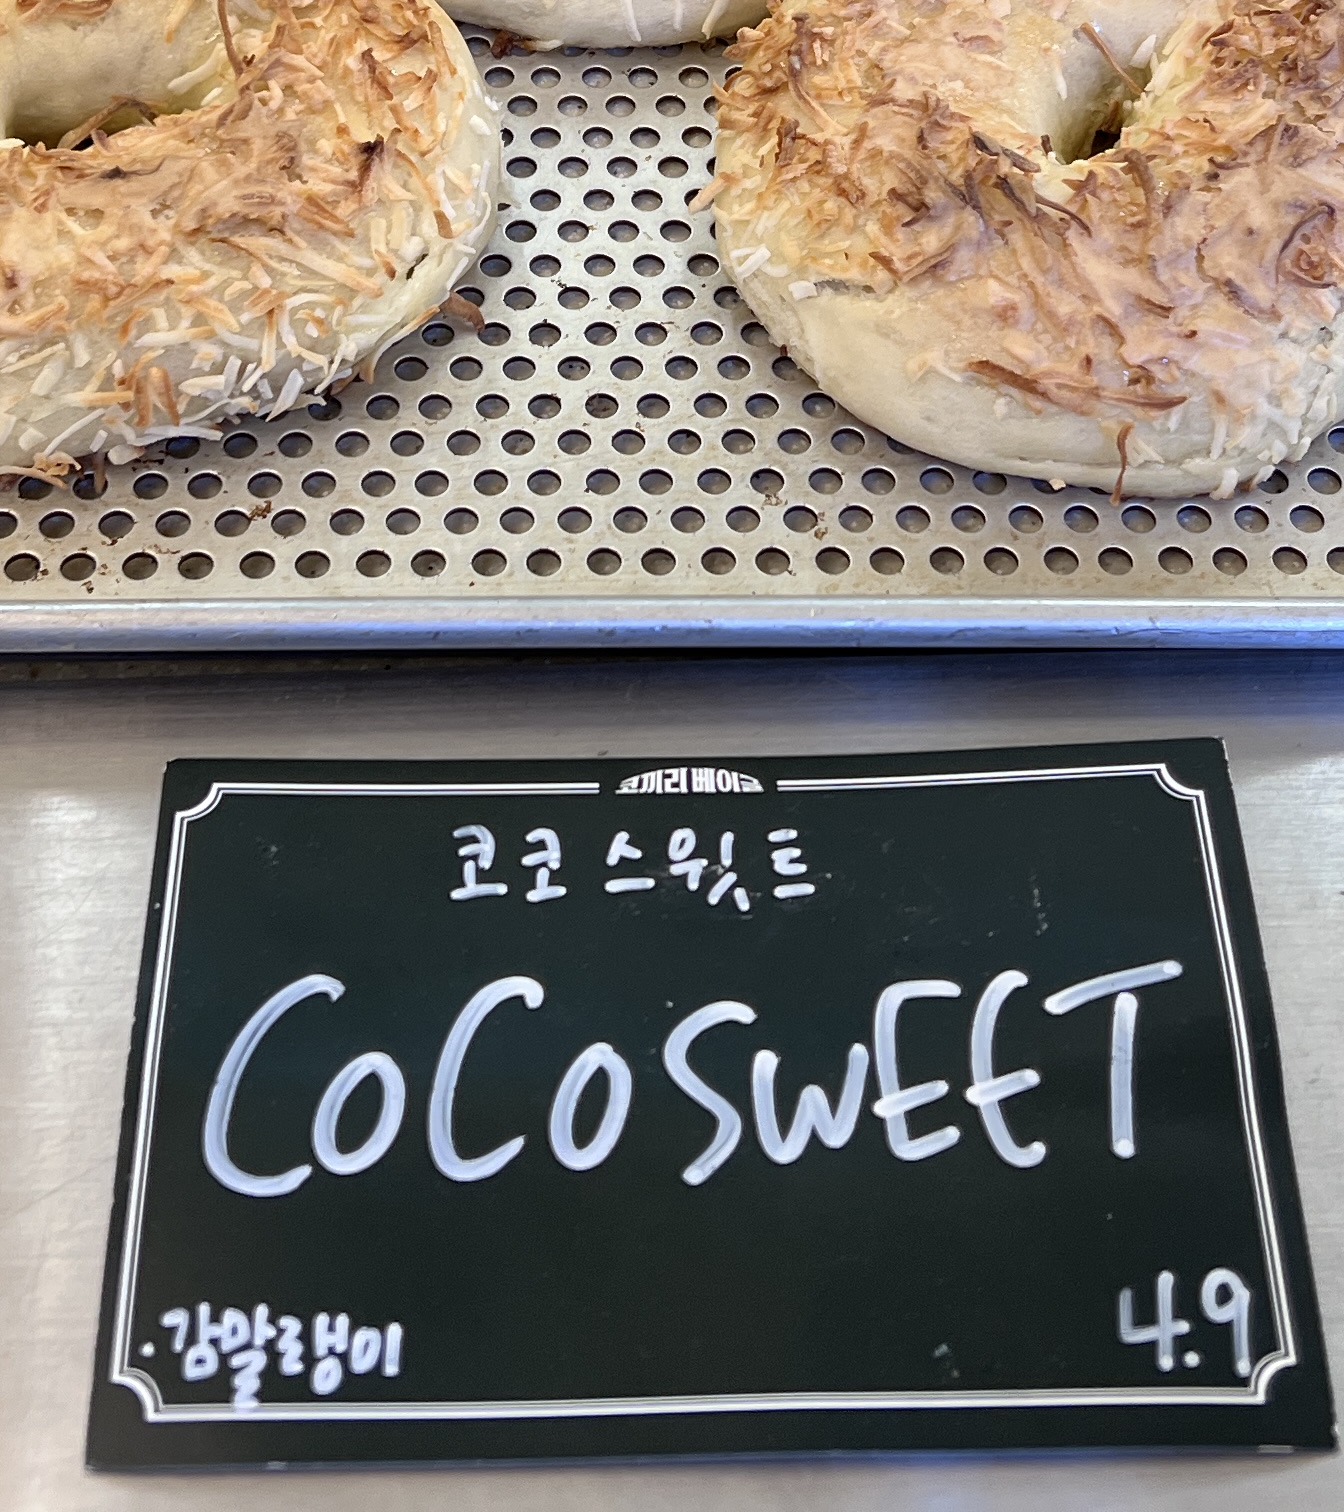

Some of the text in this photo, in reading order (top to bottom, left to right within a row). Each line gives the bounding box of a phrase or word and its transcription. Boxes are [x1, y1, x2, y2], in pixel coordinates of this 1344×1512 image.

[615, 767, 765, 795] 코끼리 베이글
[450, 824, 567, 903] 코코
[1118, 1268, 1251, 1379] 4.9
